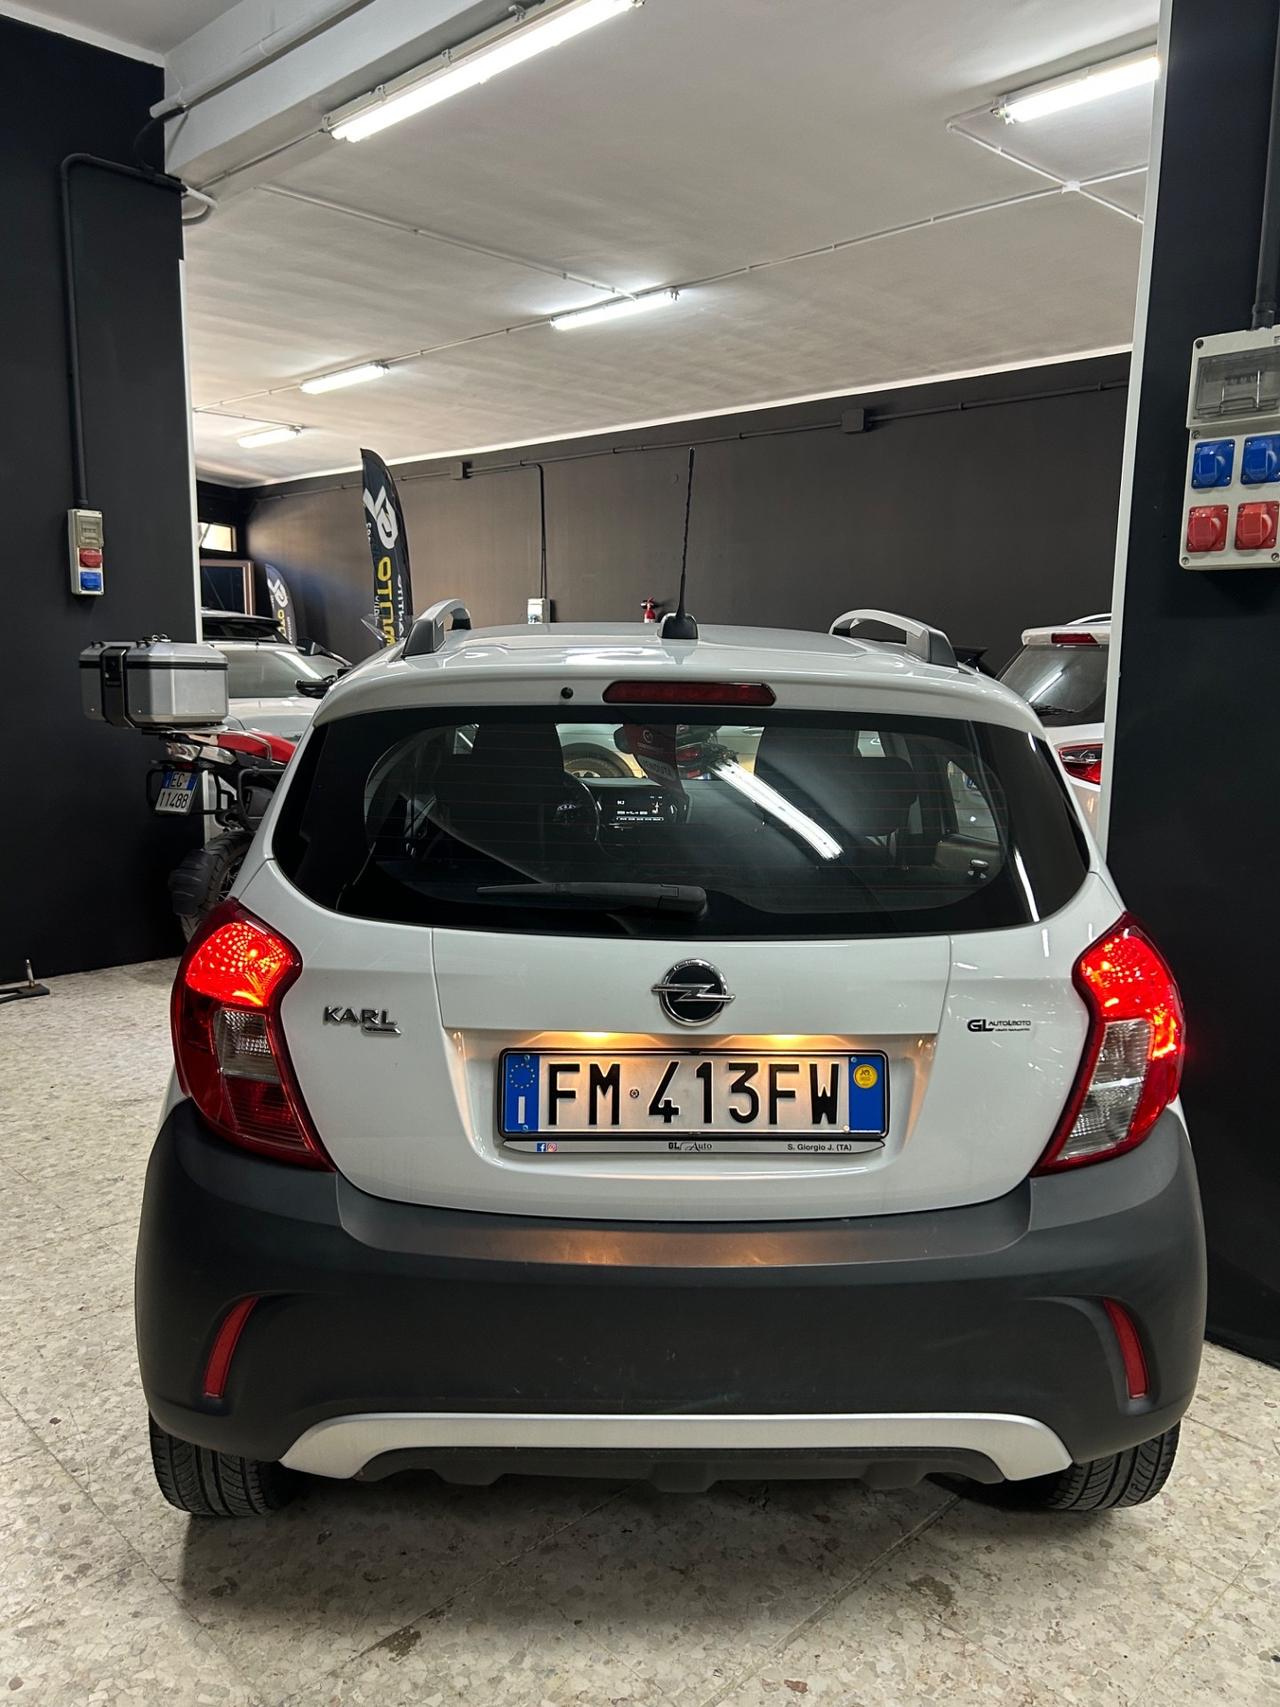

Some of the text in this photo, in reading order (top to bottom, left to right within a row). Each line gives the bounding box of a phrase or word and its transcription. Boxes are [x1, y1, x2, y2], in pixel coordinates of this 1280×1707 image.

[160, 792, 189, 809] 11488
[322, 1006, 397, 1026] KARL
[967, 1019, 994, 1032] GL
[548, 1061, 838, 1125] FM 413FW
[787, 1143, 795, 1151] S.
[797, 1143, 826, 1152] Giorgio
[836, 1143, 852, 1152] (TA)
